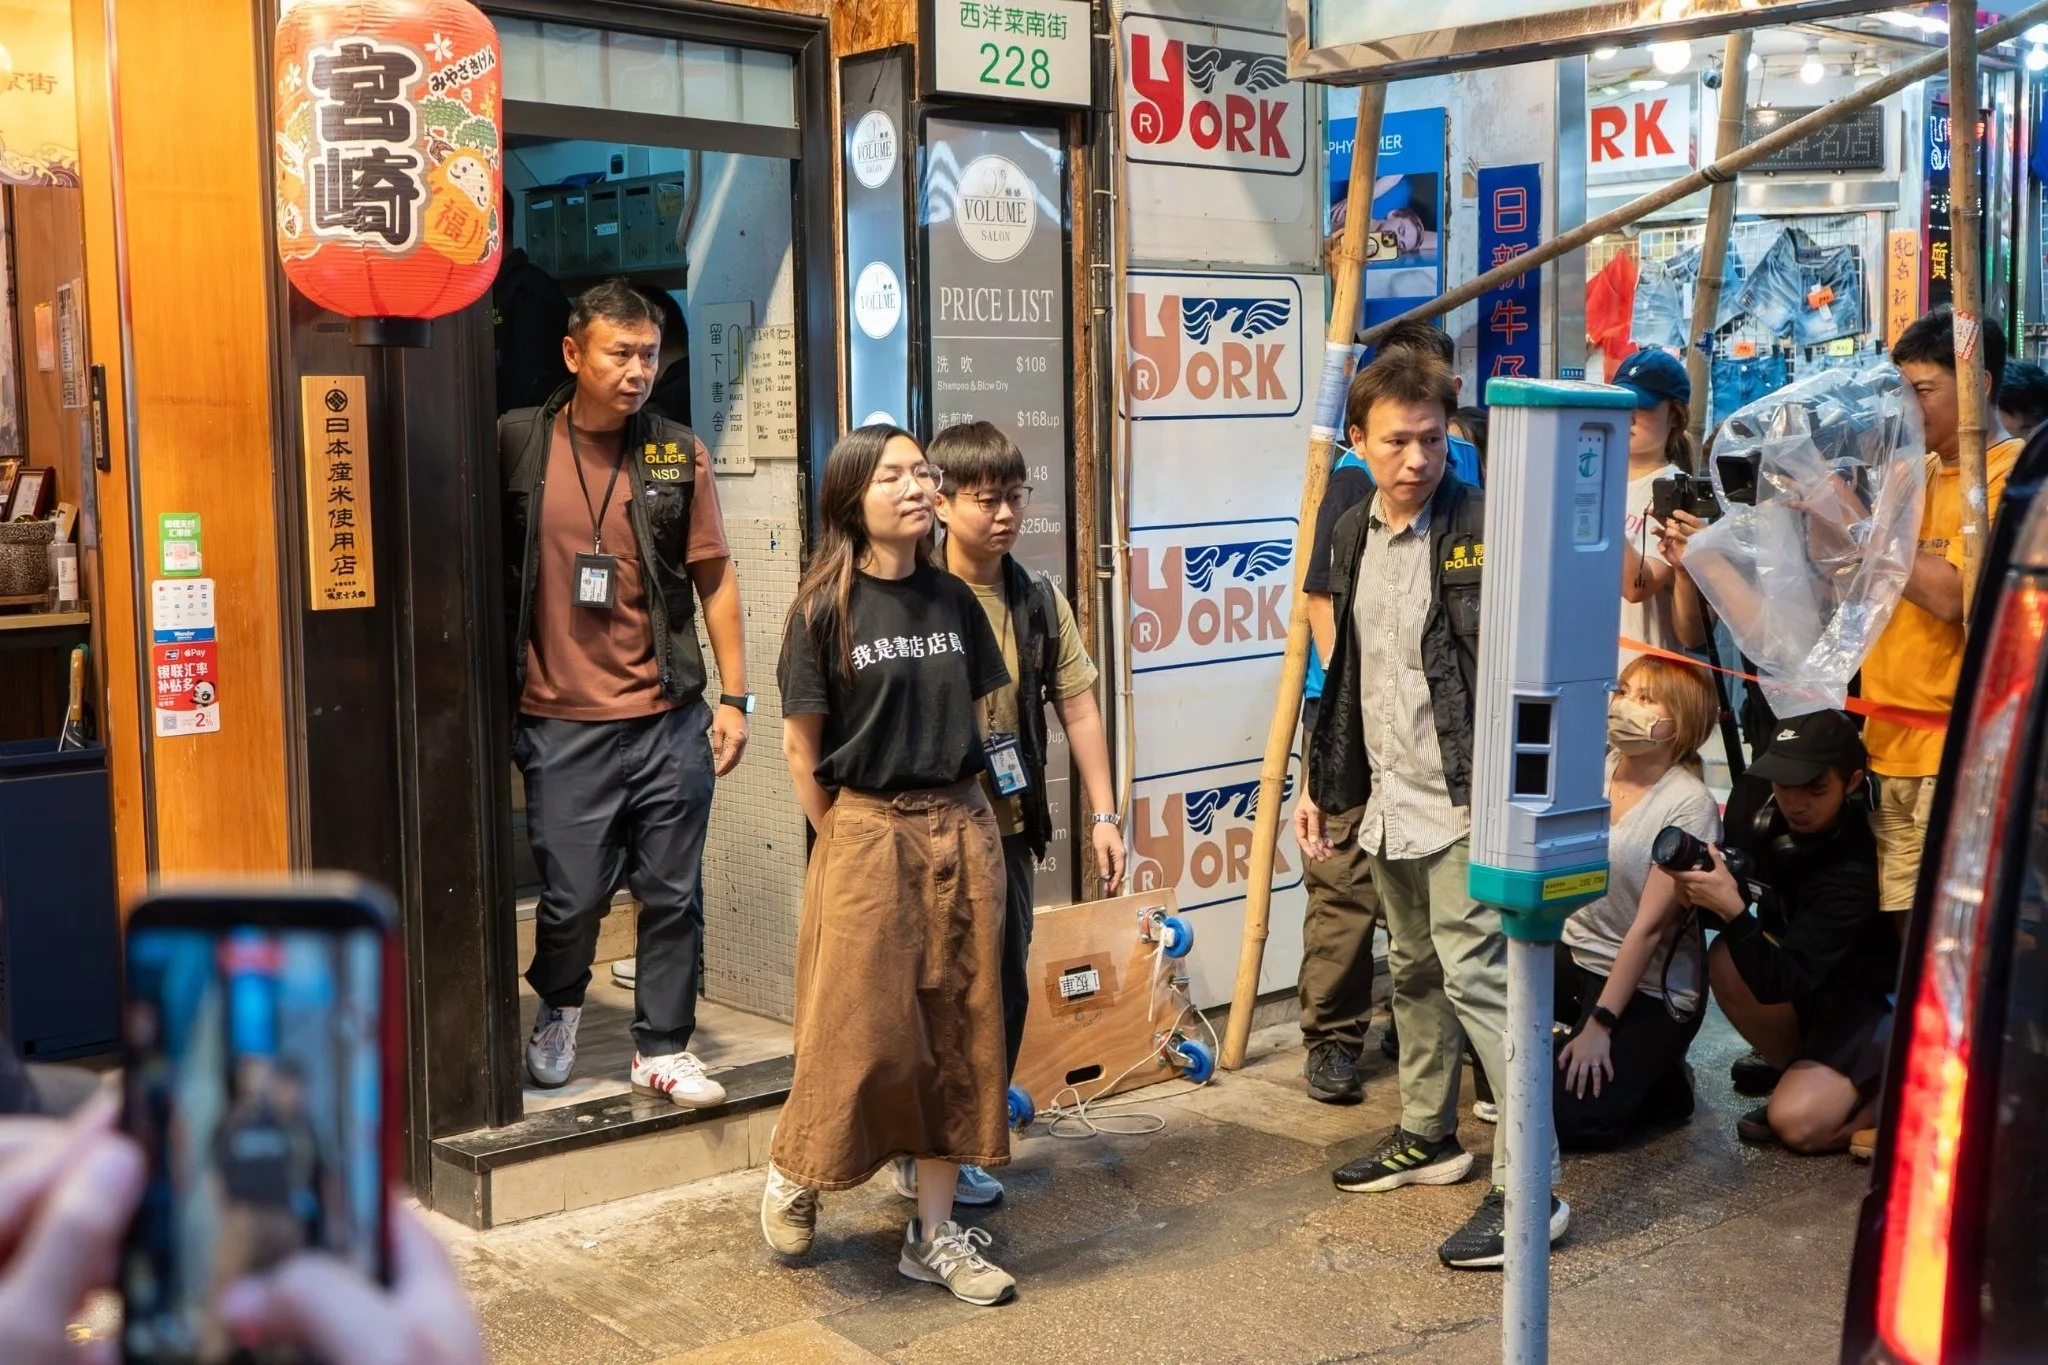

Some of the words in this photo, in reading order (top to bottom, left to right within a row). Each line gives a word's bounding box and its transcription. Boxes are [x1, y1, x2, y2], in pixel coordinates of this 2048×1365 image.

[960, 1, 1067, 40] 西洋菜南街
[979, 42, 1050, 89] 228
[311, 40, 421, 247] 宮崎
[857, 140, 892, 160] VOLUME
[964, 199, 1027, 224] VOLUME
[981, 230, 1010, 242] SALON
[939, 286, 1003, 322] PRICE
[1007, 288, 1054, 322] LIST
[1016, 356, 1046, 373] $108
[710, 323, 725, 432] 留下書舍
[937, 380, 969, 391] Shampoo
[977, 380, 995, 391] Blow
[996, 380, 1009, 392] Dry
[1017, 410, 1060, 427] $168up
[645, 454, 687, 464] OLICE
[651, 468, 680, 480] NSD
[325, 417, 357, 576] 日本産米使用店
[1019, 517, 1061, 535] $250up
[1444, 556, 1484, 571] POLIC
[191, 648, 206, 658] Pay
[851, 632, 965, 670] 我是書店店員
[157, 662, 209, 680] 银联汇率
[157, 677, 194, 695] 补贴多
